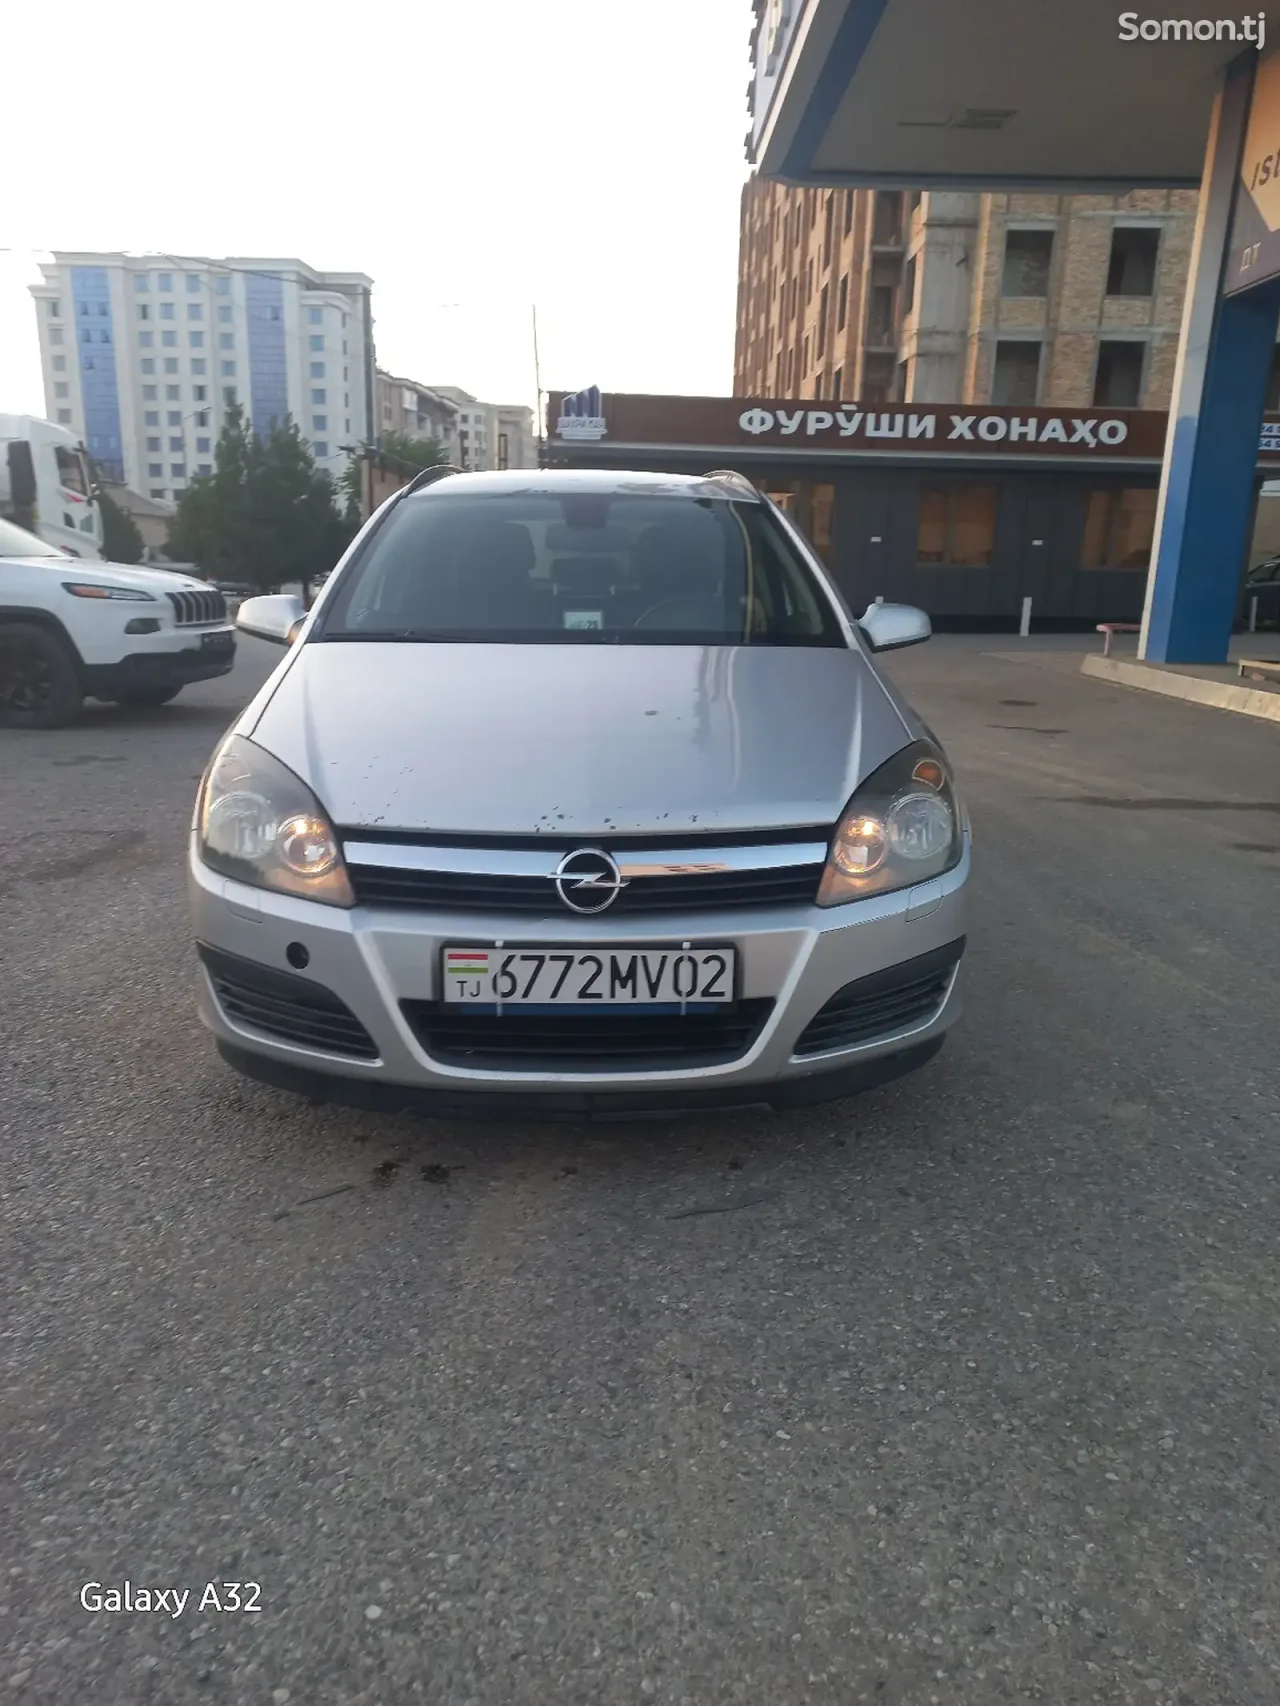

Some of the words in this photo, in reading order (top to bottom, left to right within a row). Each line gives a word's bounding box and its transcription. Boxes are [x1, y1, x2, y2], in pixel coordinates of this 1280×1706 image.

[947, 414, 1128, 448] ХОНАҲО
[456, 980, 481, 998] TJ
[492, 953, 727, 1000] 6772MV02
